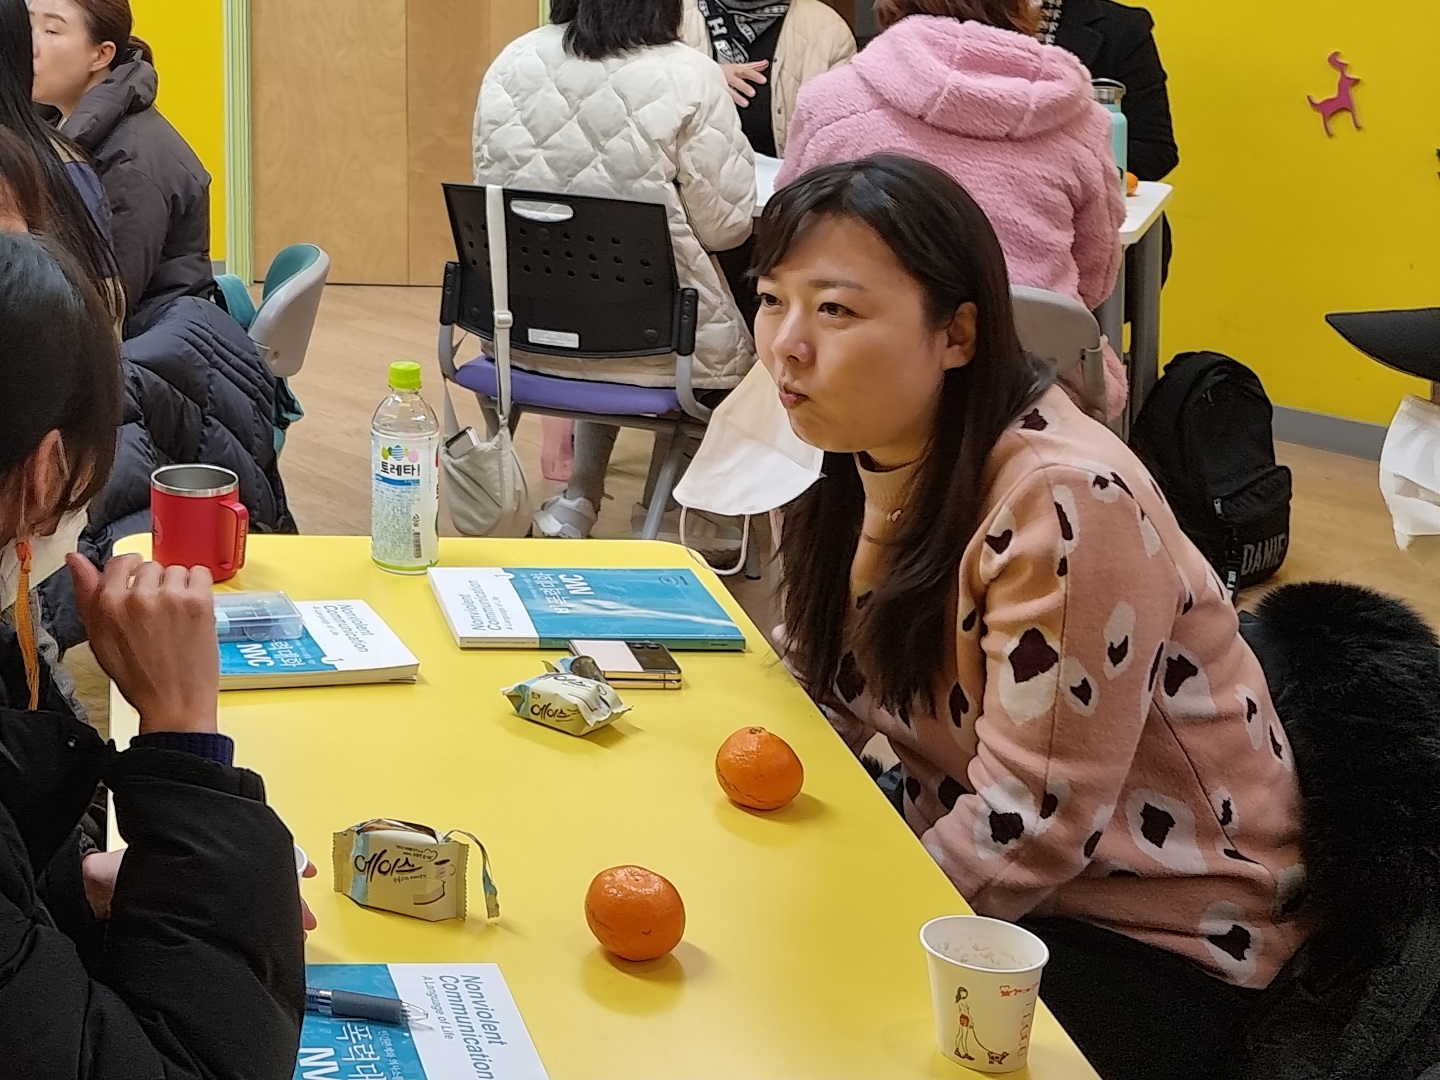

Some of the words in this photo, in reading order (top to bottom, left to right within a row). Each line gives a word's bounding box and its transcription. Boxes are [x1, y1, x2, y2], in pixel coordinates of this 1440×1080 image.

[380, 460, 421, 477] 토레타!
[559, 573, 595, 596] NVC
[236, 643, 275, 667] NVC
[353, 849, 423, 883] 에이스
[424, 981, 445, 1015] Language
[440, 1024, 455, 1040] Life
[460, 974, 508, 1046] Nonviolent
[438, 975, 495, 1080] Communication
